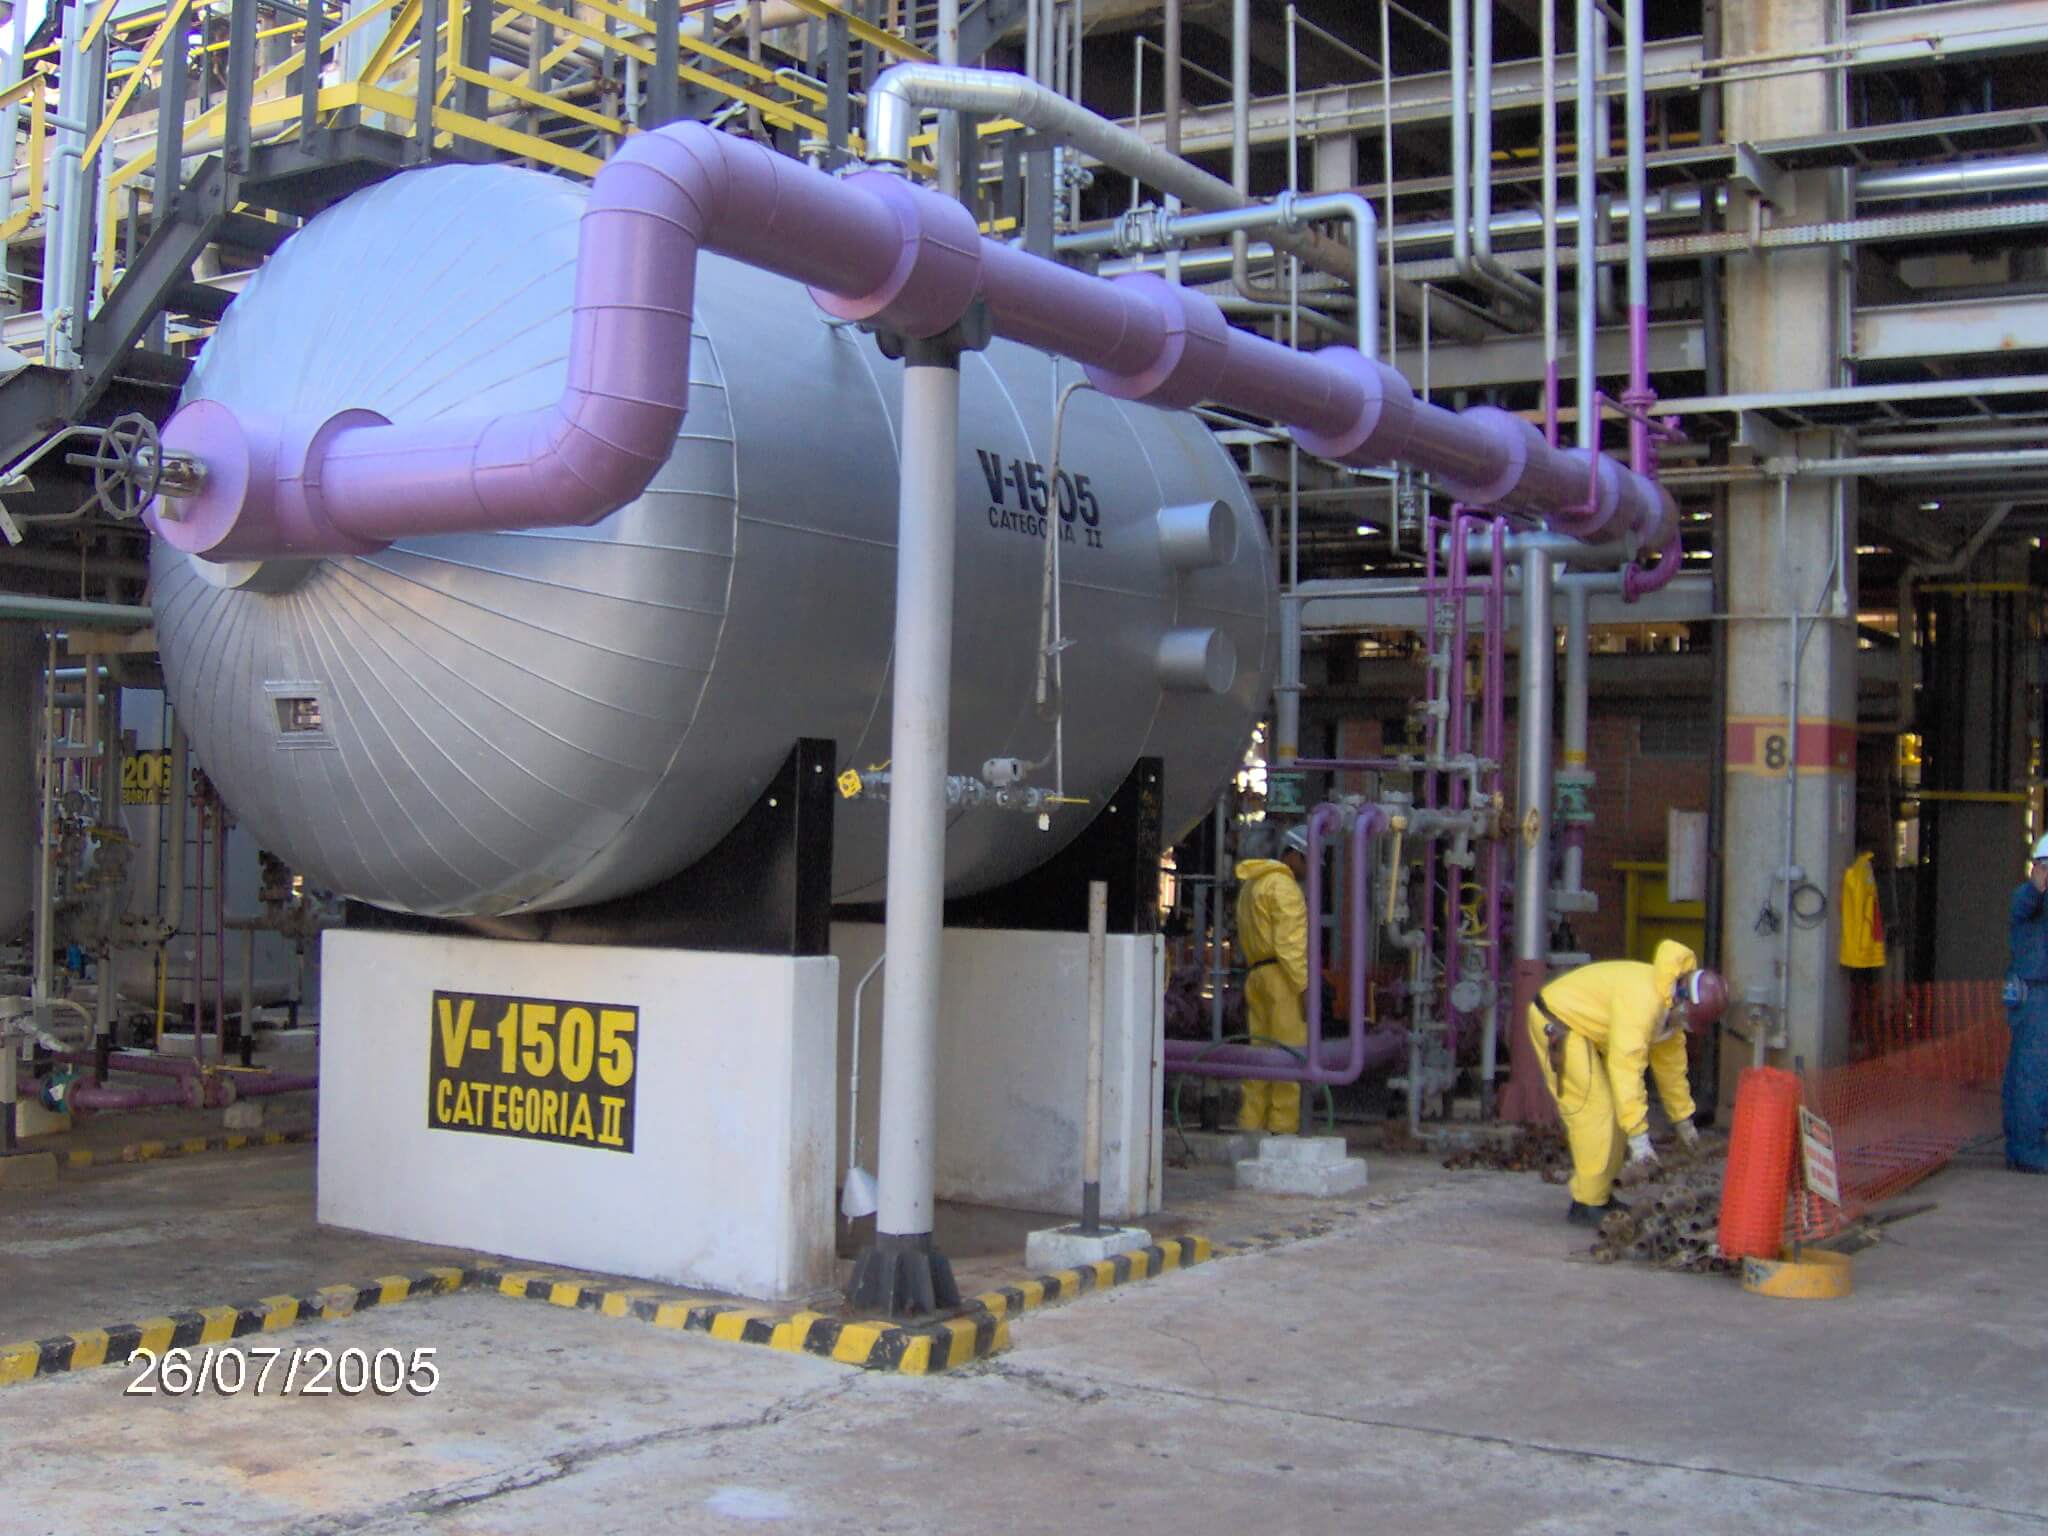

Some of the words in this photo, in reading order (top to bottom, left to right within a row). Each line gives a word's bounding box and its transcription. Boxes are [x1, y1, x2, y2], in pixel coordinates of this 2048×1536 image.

[976, 448, 1100, 527] V-1505
[1765, 735, 1786, 769] 8
[437, 998, 636, 1087] V-1505
[435, 1078, 595, 1140] CATEGORIA
[597, 1095, 626, 1146] II
